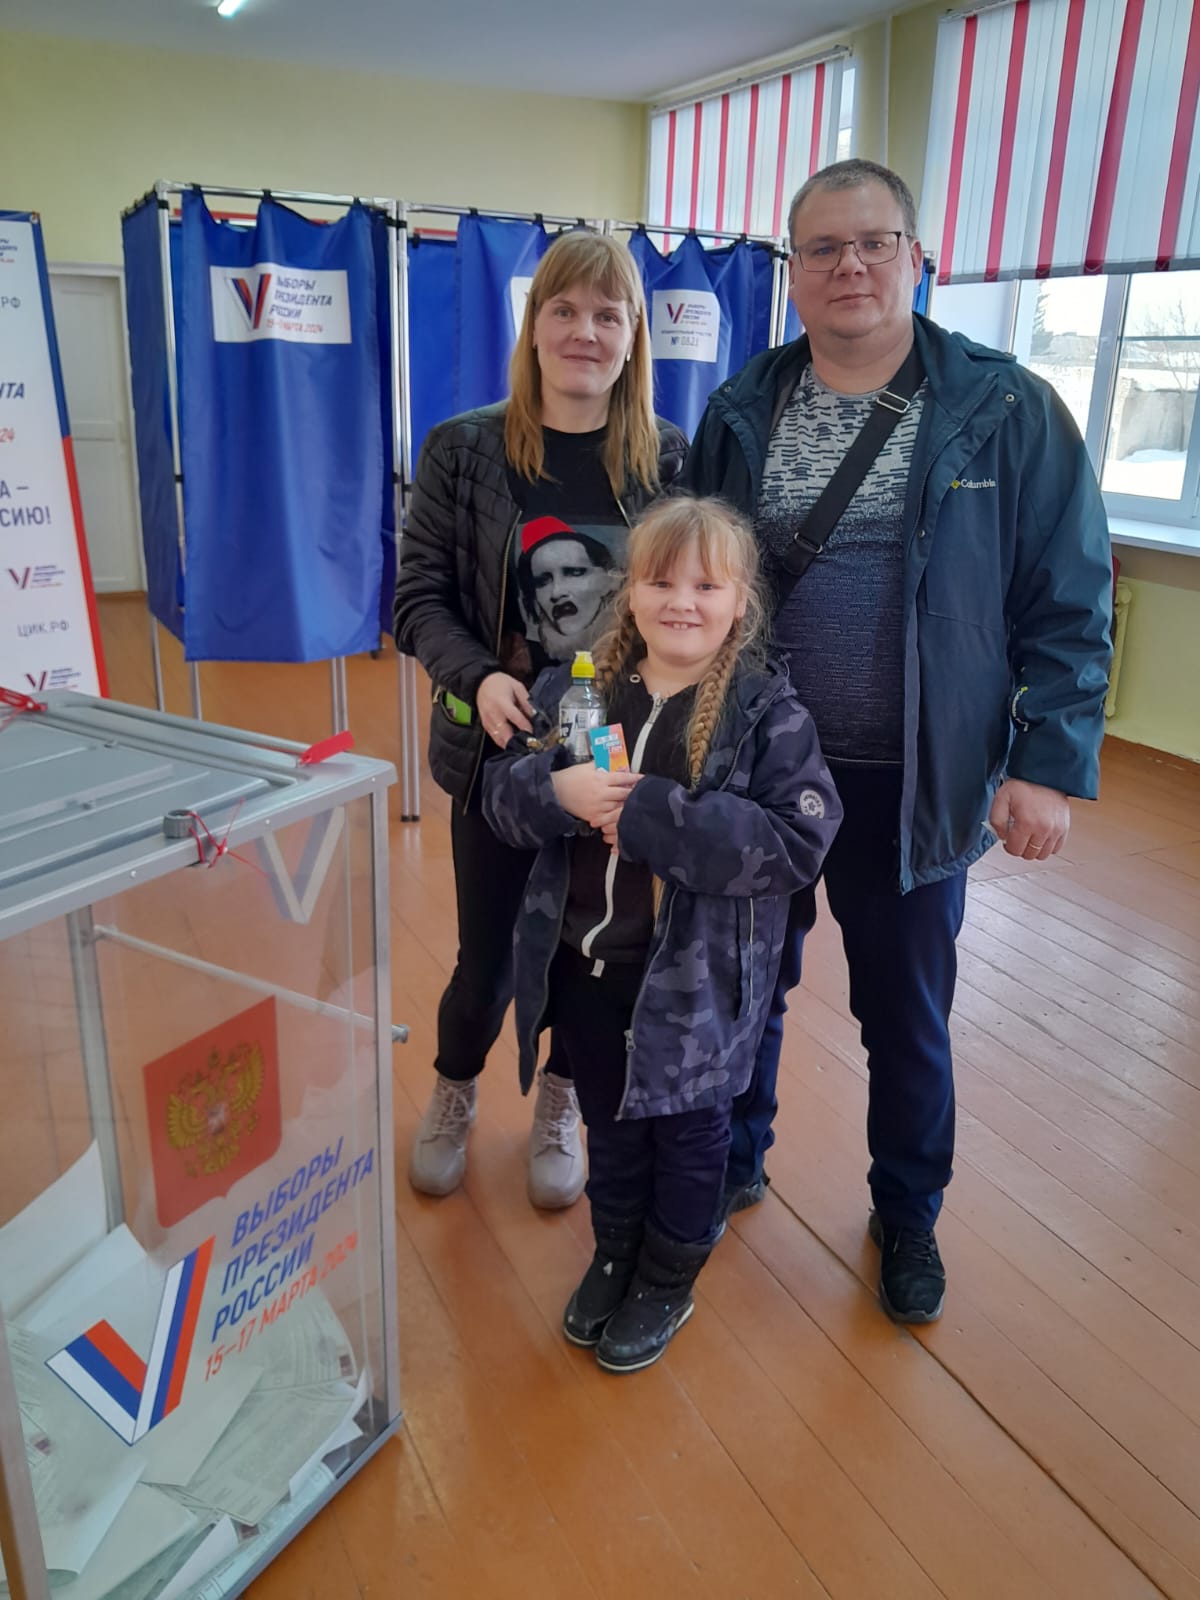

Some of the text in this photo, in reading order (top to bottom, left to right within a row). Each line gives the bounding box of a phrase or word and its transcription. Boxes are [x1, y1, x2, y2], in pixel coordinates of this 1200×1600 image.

[960, 478, 996, 489] Columbia
[221, 1147, 374, 1296] ПРЕЗИДЕНТА
[231, 1136, 343, 1248] ВЫБОРЫ
[212, 1232, 315, 1343] РОССИИ
[259, 1265, 317, 1334] МАРТА
[320, 1231, 358, 1280] 2024
